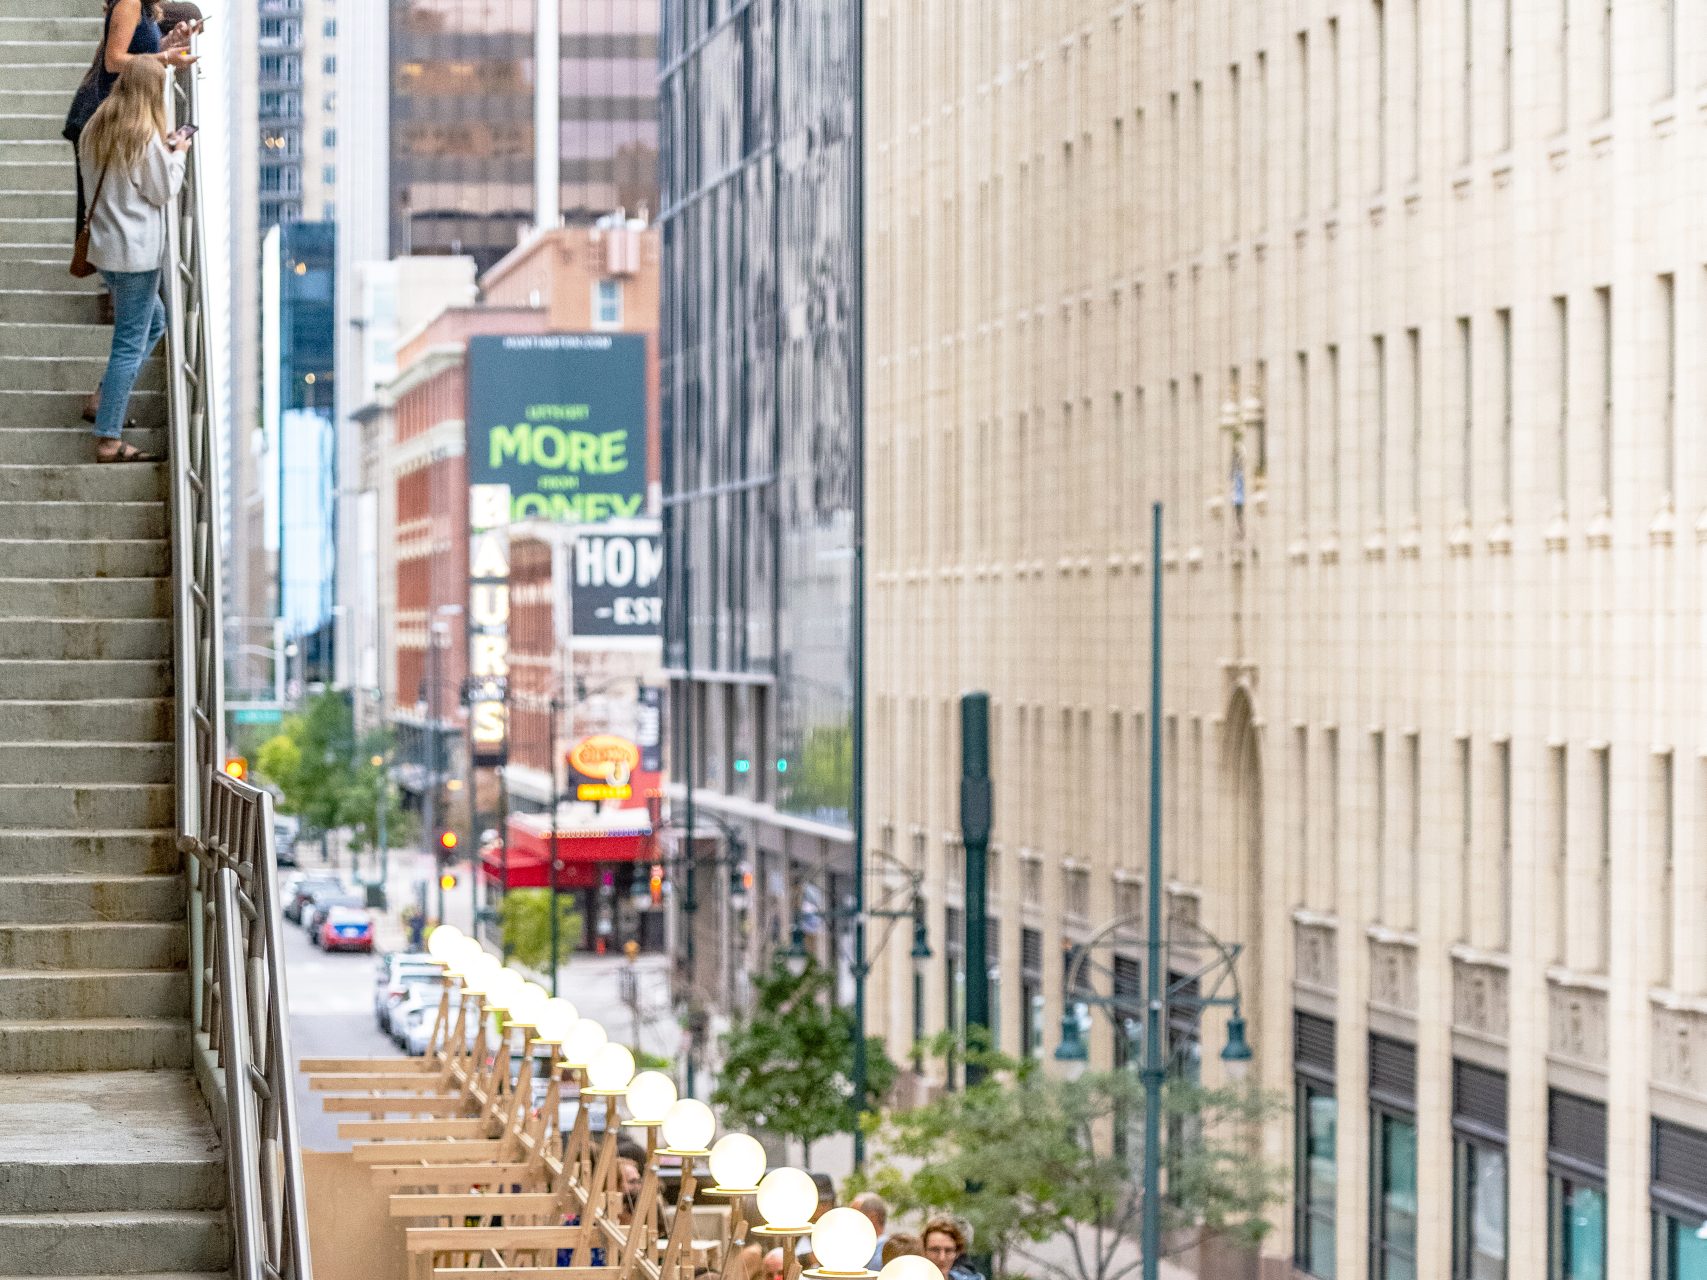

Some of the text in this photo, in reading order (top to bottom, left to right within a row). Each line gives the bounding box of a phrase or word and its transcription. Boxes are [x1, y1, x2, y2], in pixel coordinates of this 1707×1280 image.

[489, 423, 628, 475] MORE
[510, 492, 643, 522] ONEY
[576, 537, 663, 588] HOM
